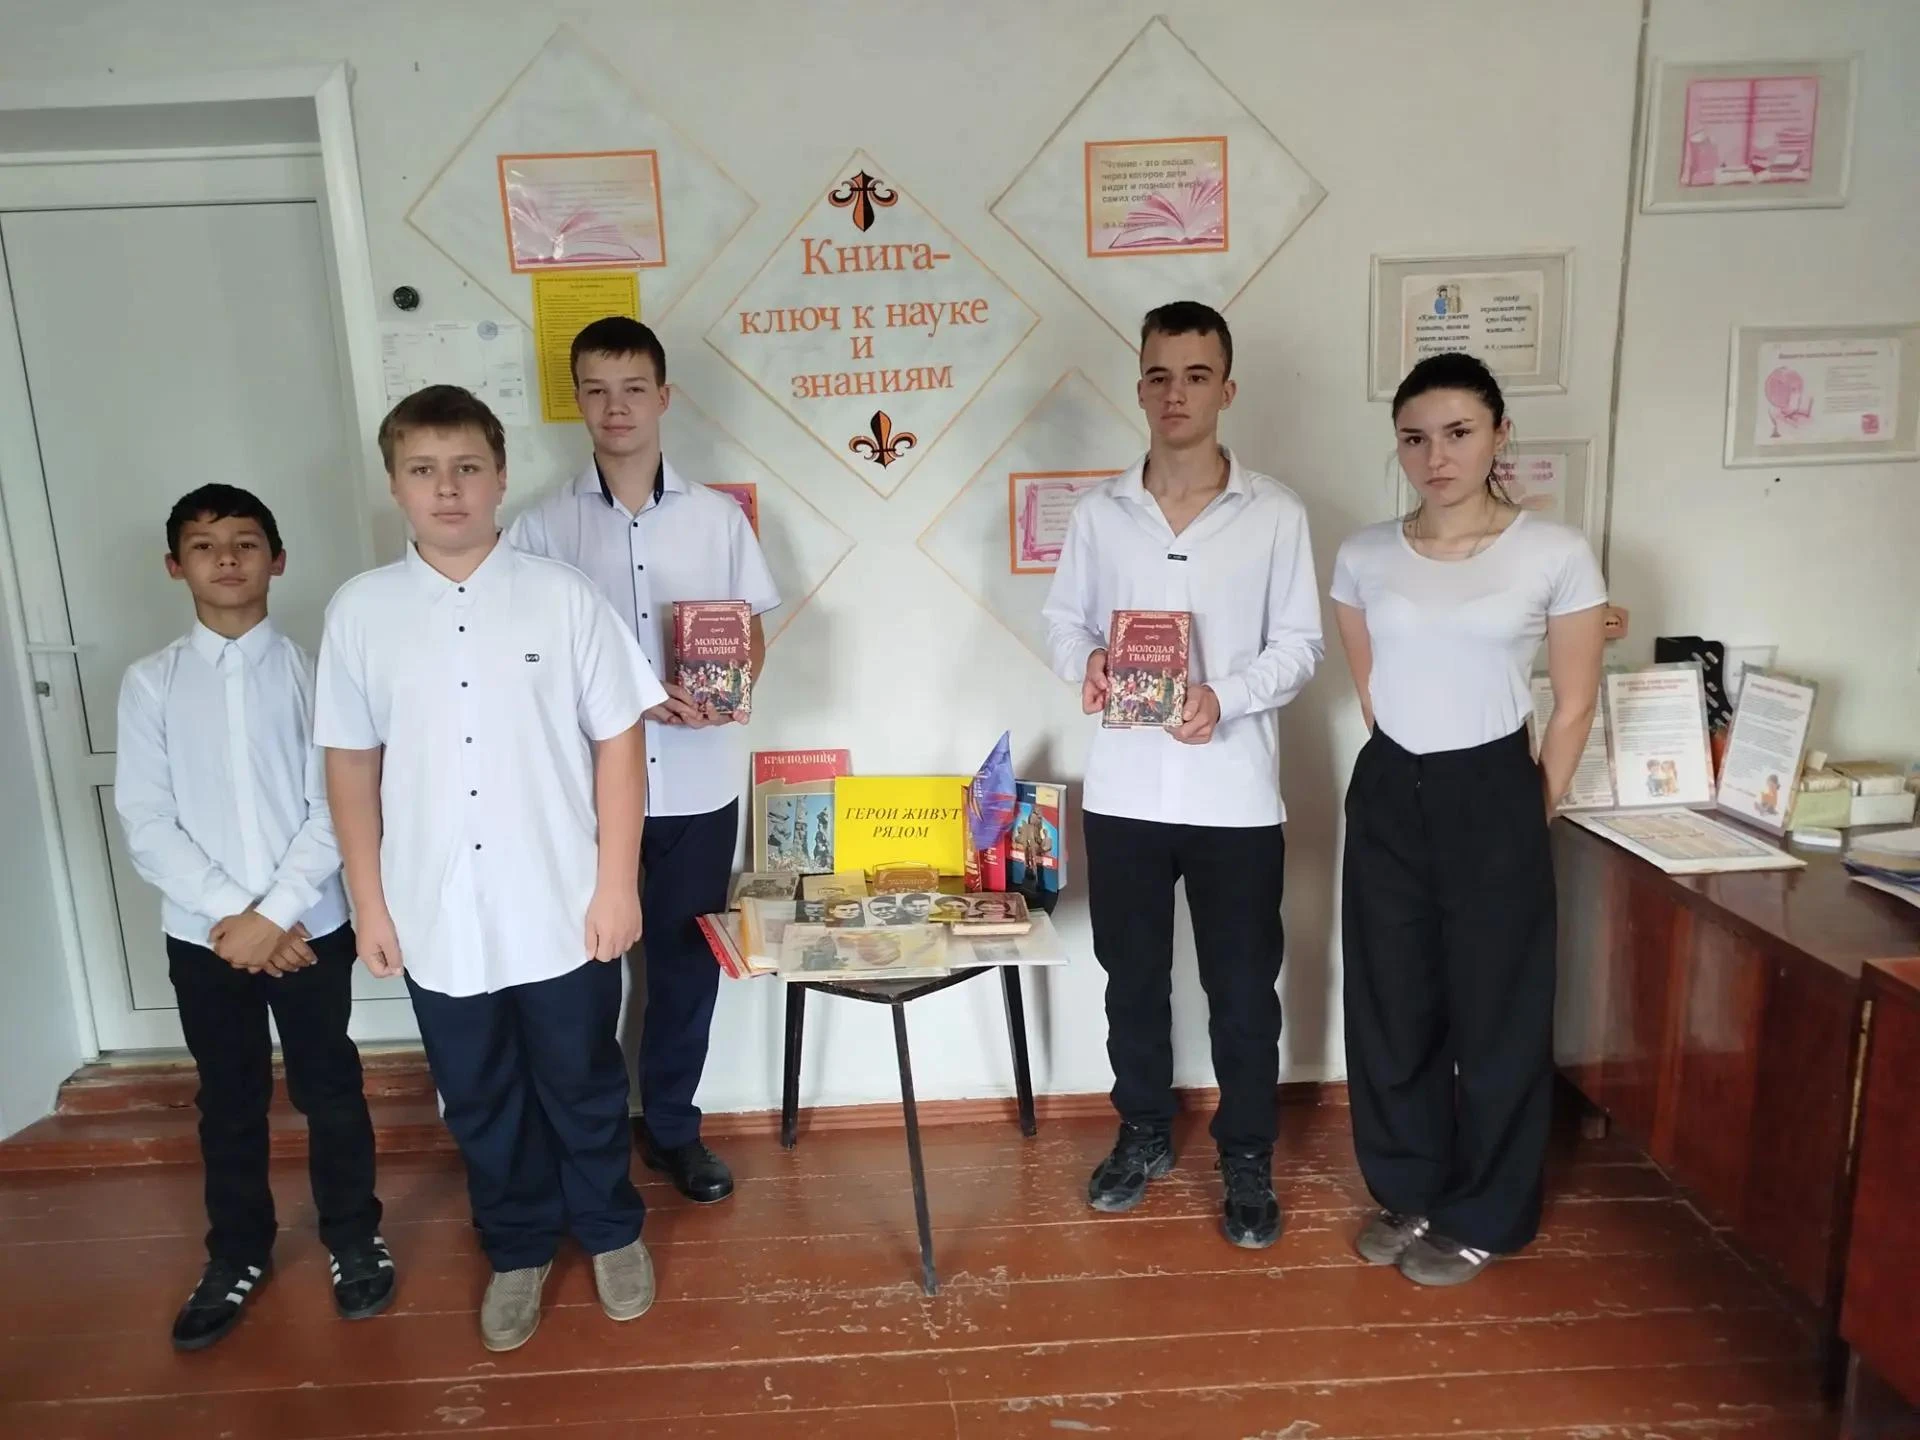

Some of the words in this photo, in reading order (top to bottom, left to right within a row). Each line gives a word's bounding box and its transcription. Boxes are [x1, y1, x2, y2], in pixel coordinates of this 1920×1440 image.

[1129, 171, 1164, 180] которое
[1101, 184, 1128, 192] видят
[1138, 182, 1175, 190] познают
[1102, 195, 1129, 203] самих
[800, 236, 951, 275] Книга-
[739, 306, 841, 334] ключ
[851, 305, 875, 329] к
[885, 298, 989, 337] науке
[850, 336, 874, 359] и
[791, 365, 954, 399] знаниям
[694, 637, 739, 646] МОЛОДАЯ
[697, 646, 737, 655] ГВАРДИЯ
[1127, 644, 1175, 654] МОЛОДАЯ
[1129, 653, 1171, 663] ГВАРДИЯ
[763, 752, 837, 765] КРАСНОДОНЦЫ
[845, 807, 898, 820] ГЕРОИ
[901, 807, 962, 820] ЖИВУТ
[872, 826, 930, 839] РЯДОМ
